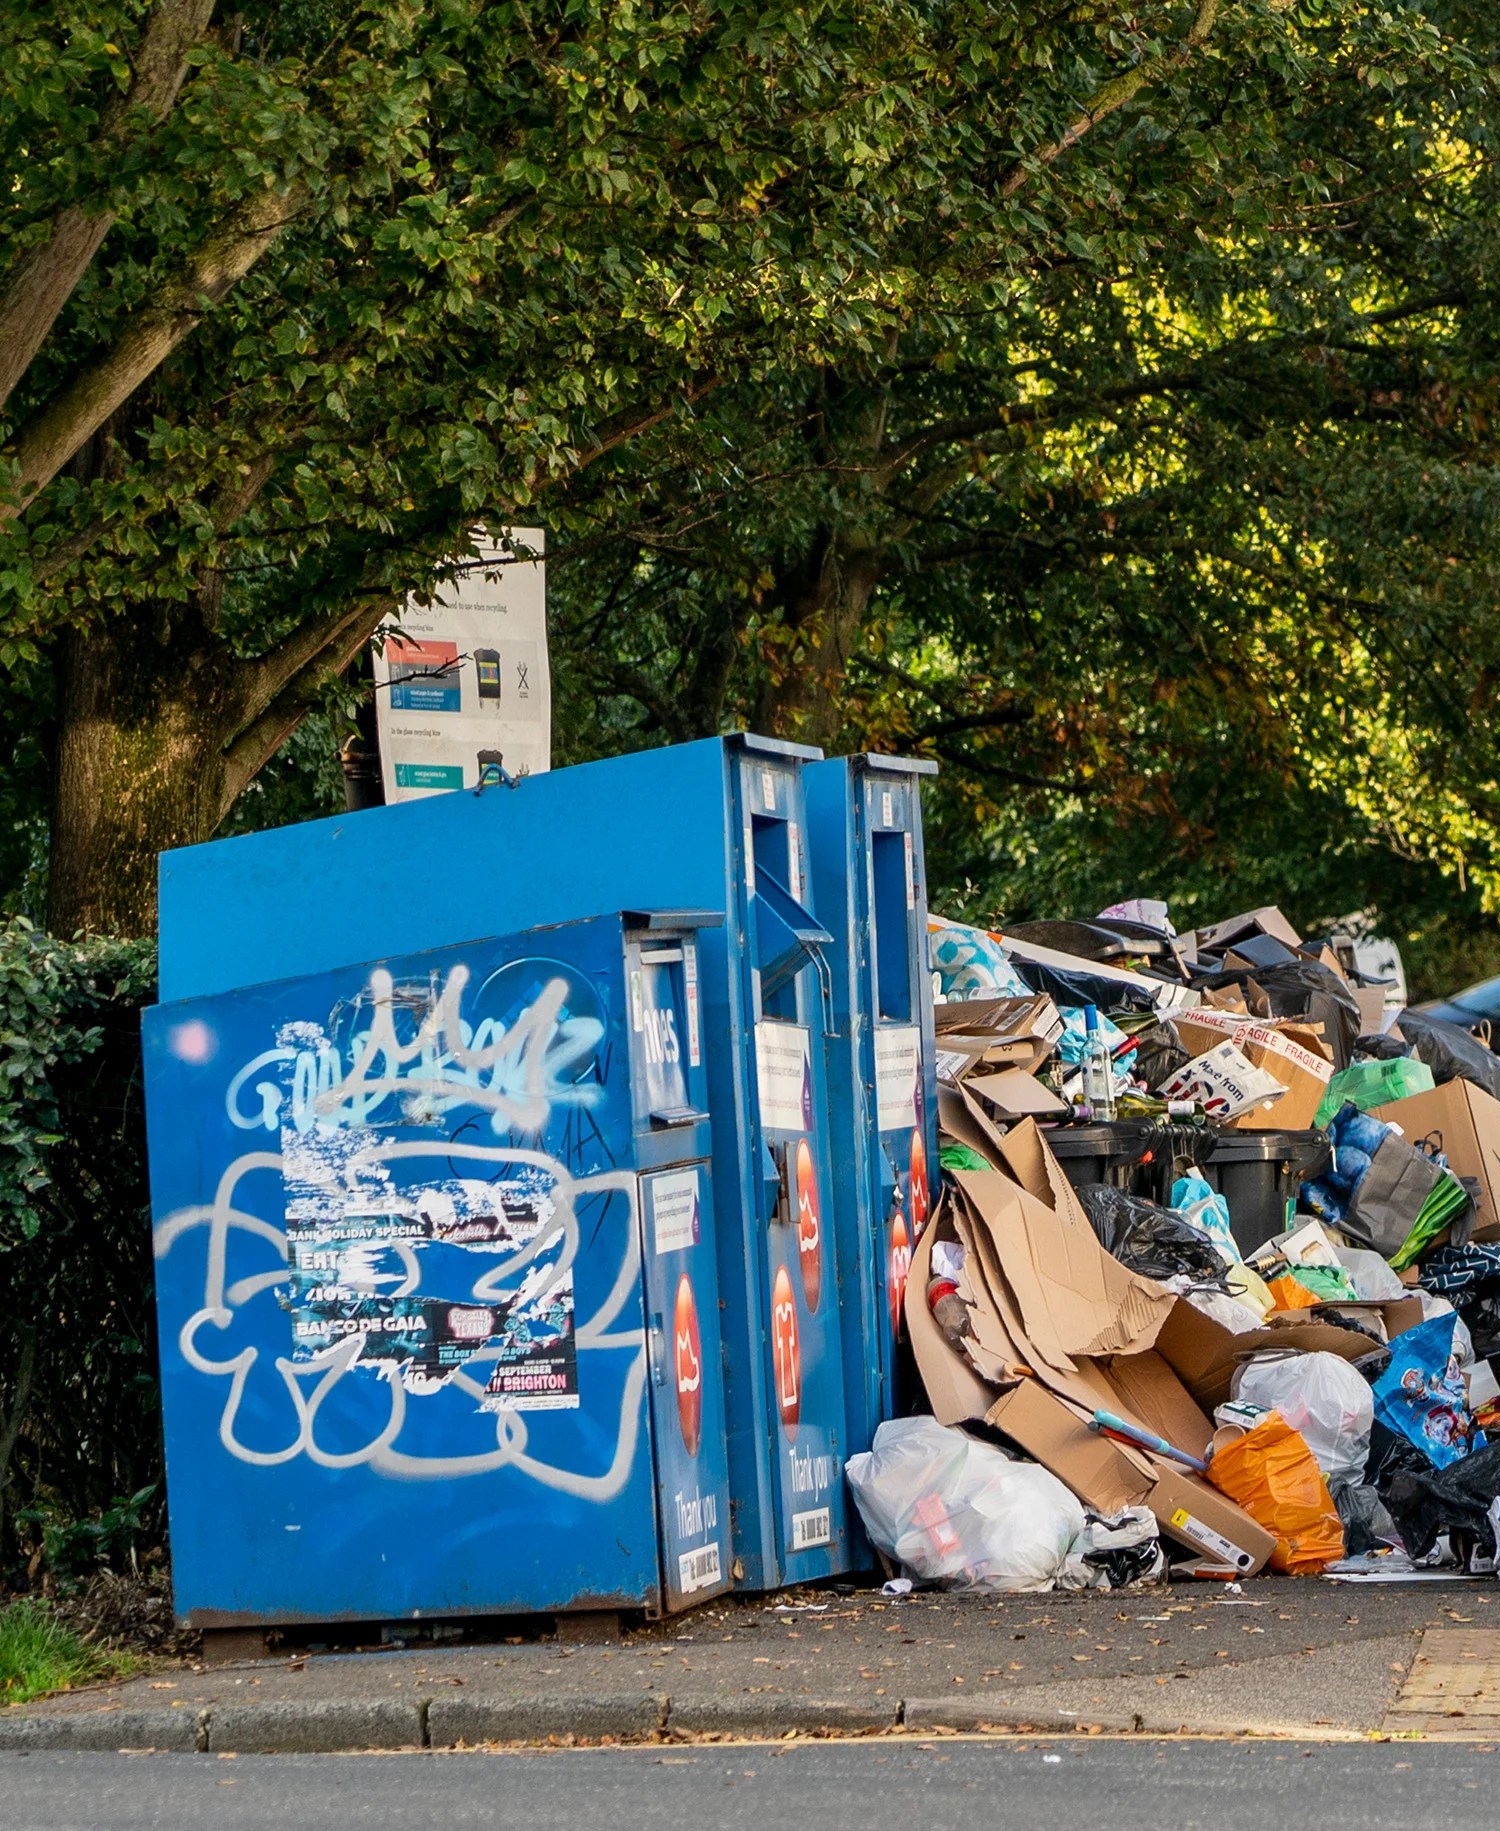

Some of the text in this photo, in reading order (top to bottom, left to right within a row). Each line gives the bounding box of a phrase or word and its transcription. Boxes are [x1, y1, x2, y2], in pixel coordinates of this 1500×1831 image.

[1247, 1026, 1324, 1074] AGILE FRAGILE
[1220, 1077, 1245, 1102] from
[375, 1224, 425, 1238] SPECIAL
[295, 1318, 358, 1337] BANCO
[358, 1317, 382, 1333] DE
[382, 1314, 428, 1332] GAIA
[498, 1364, 552, 1377] SEPTEMBER
[503, 1374, 567, 1391] BRIGHTON
